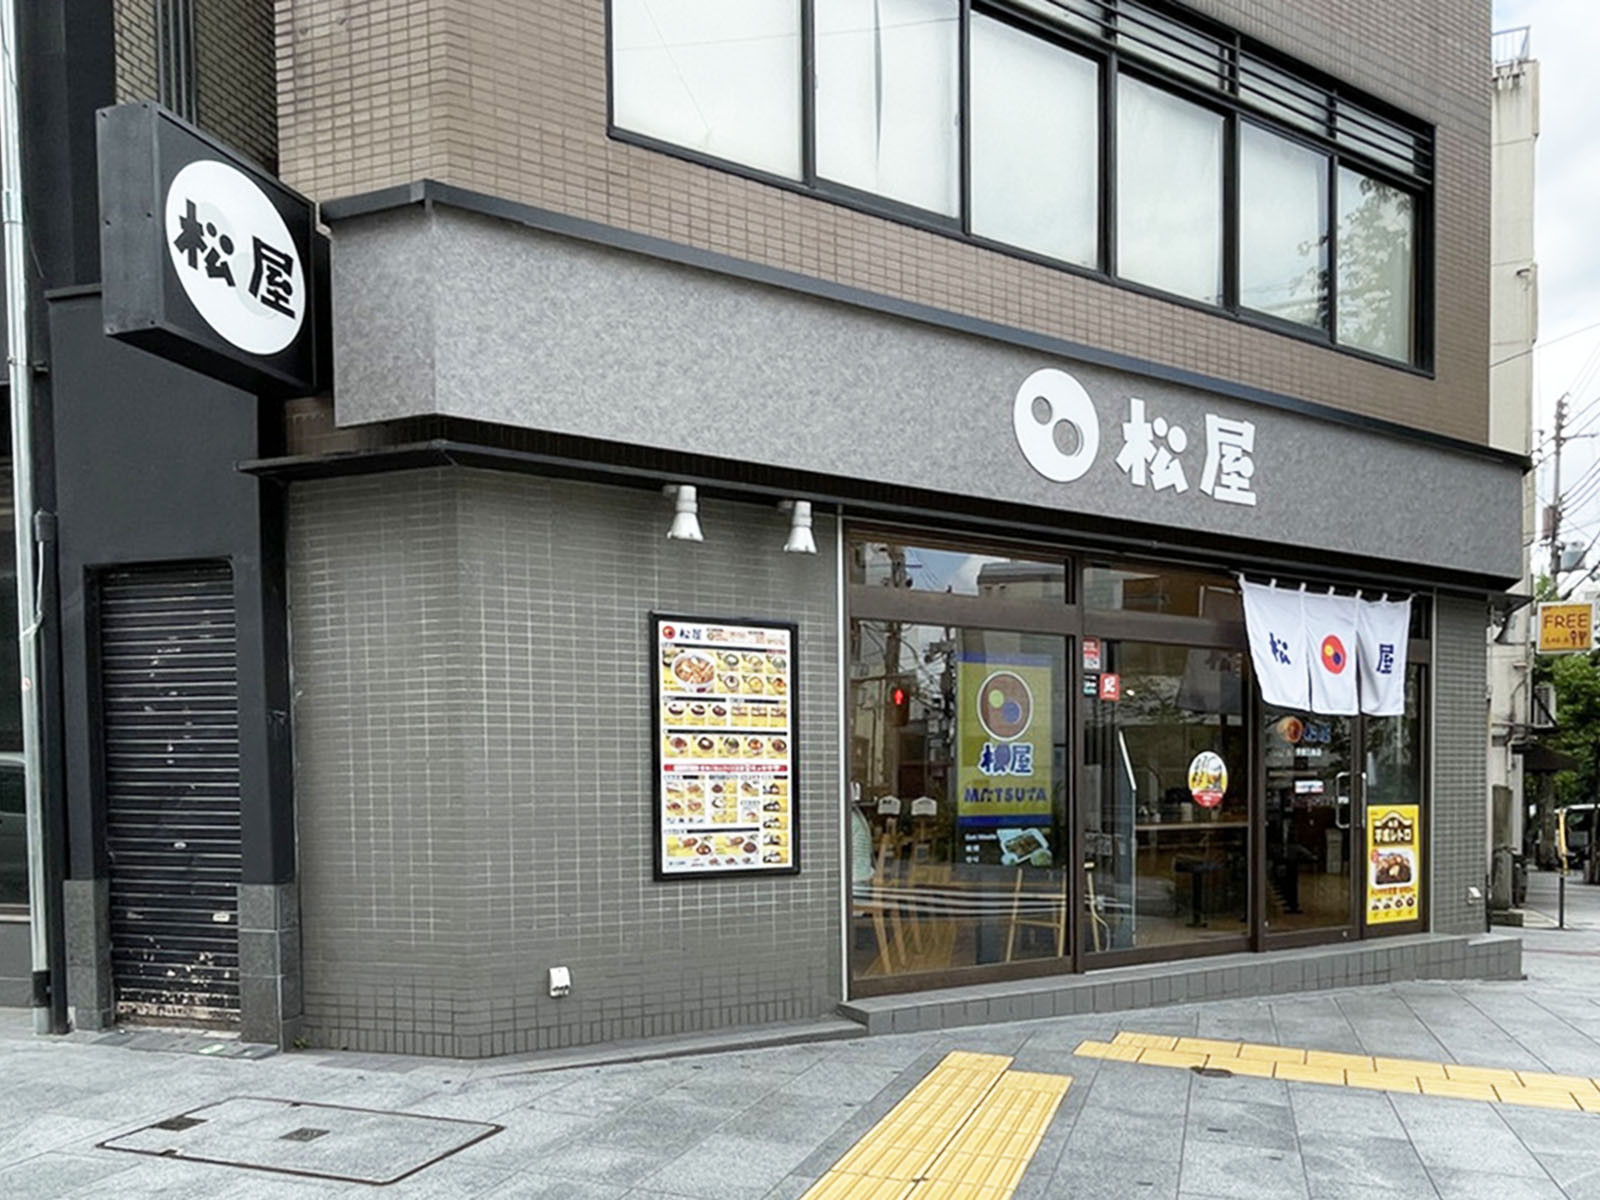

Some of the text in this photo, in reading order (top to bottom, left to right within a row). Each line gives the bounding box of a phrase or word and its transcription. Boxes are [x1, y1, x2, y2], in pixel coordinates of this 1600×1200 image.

[173, 198, 296, 320] 松屋
[1115, 397, 1257, 506] 松屋
[1269, 632, 1394, 674] 松 屋
[1543, 612, 1588, 629] FREE
